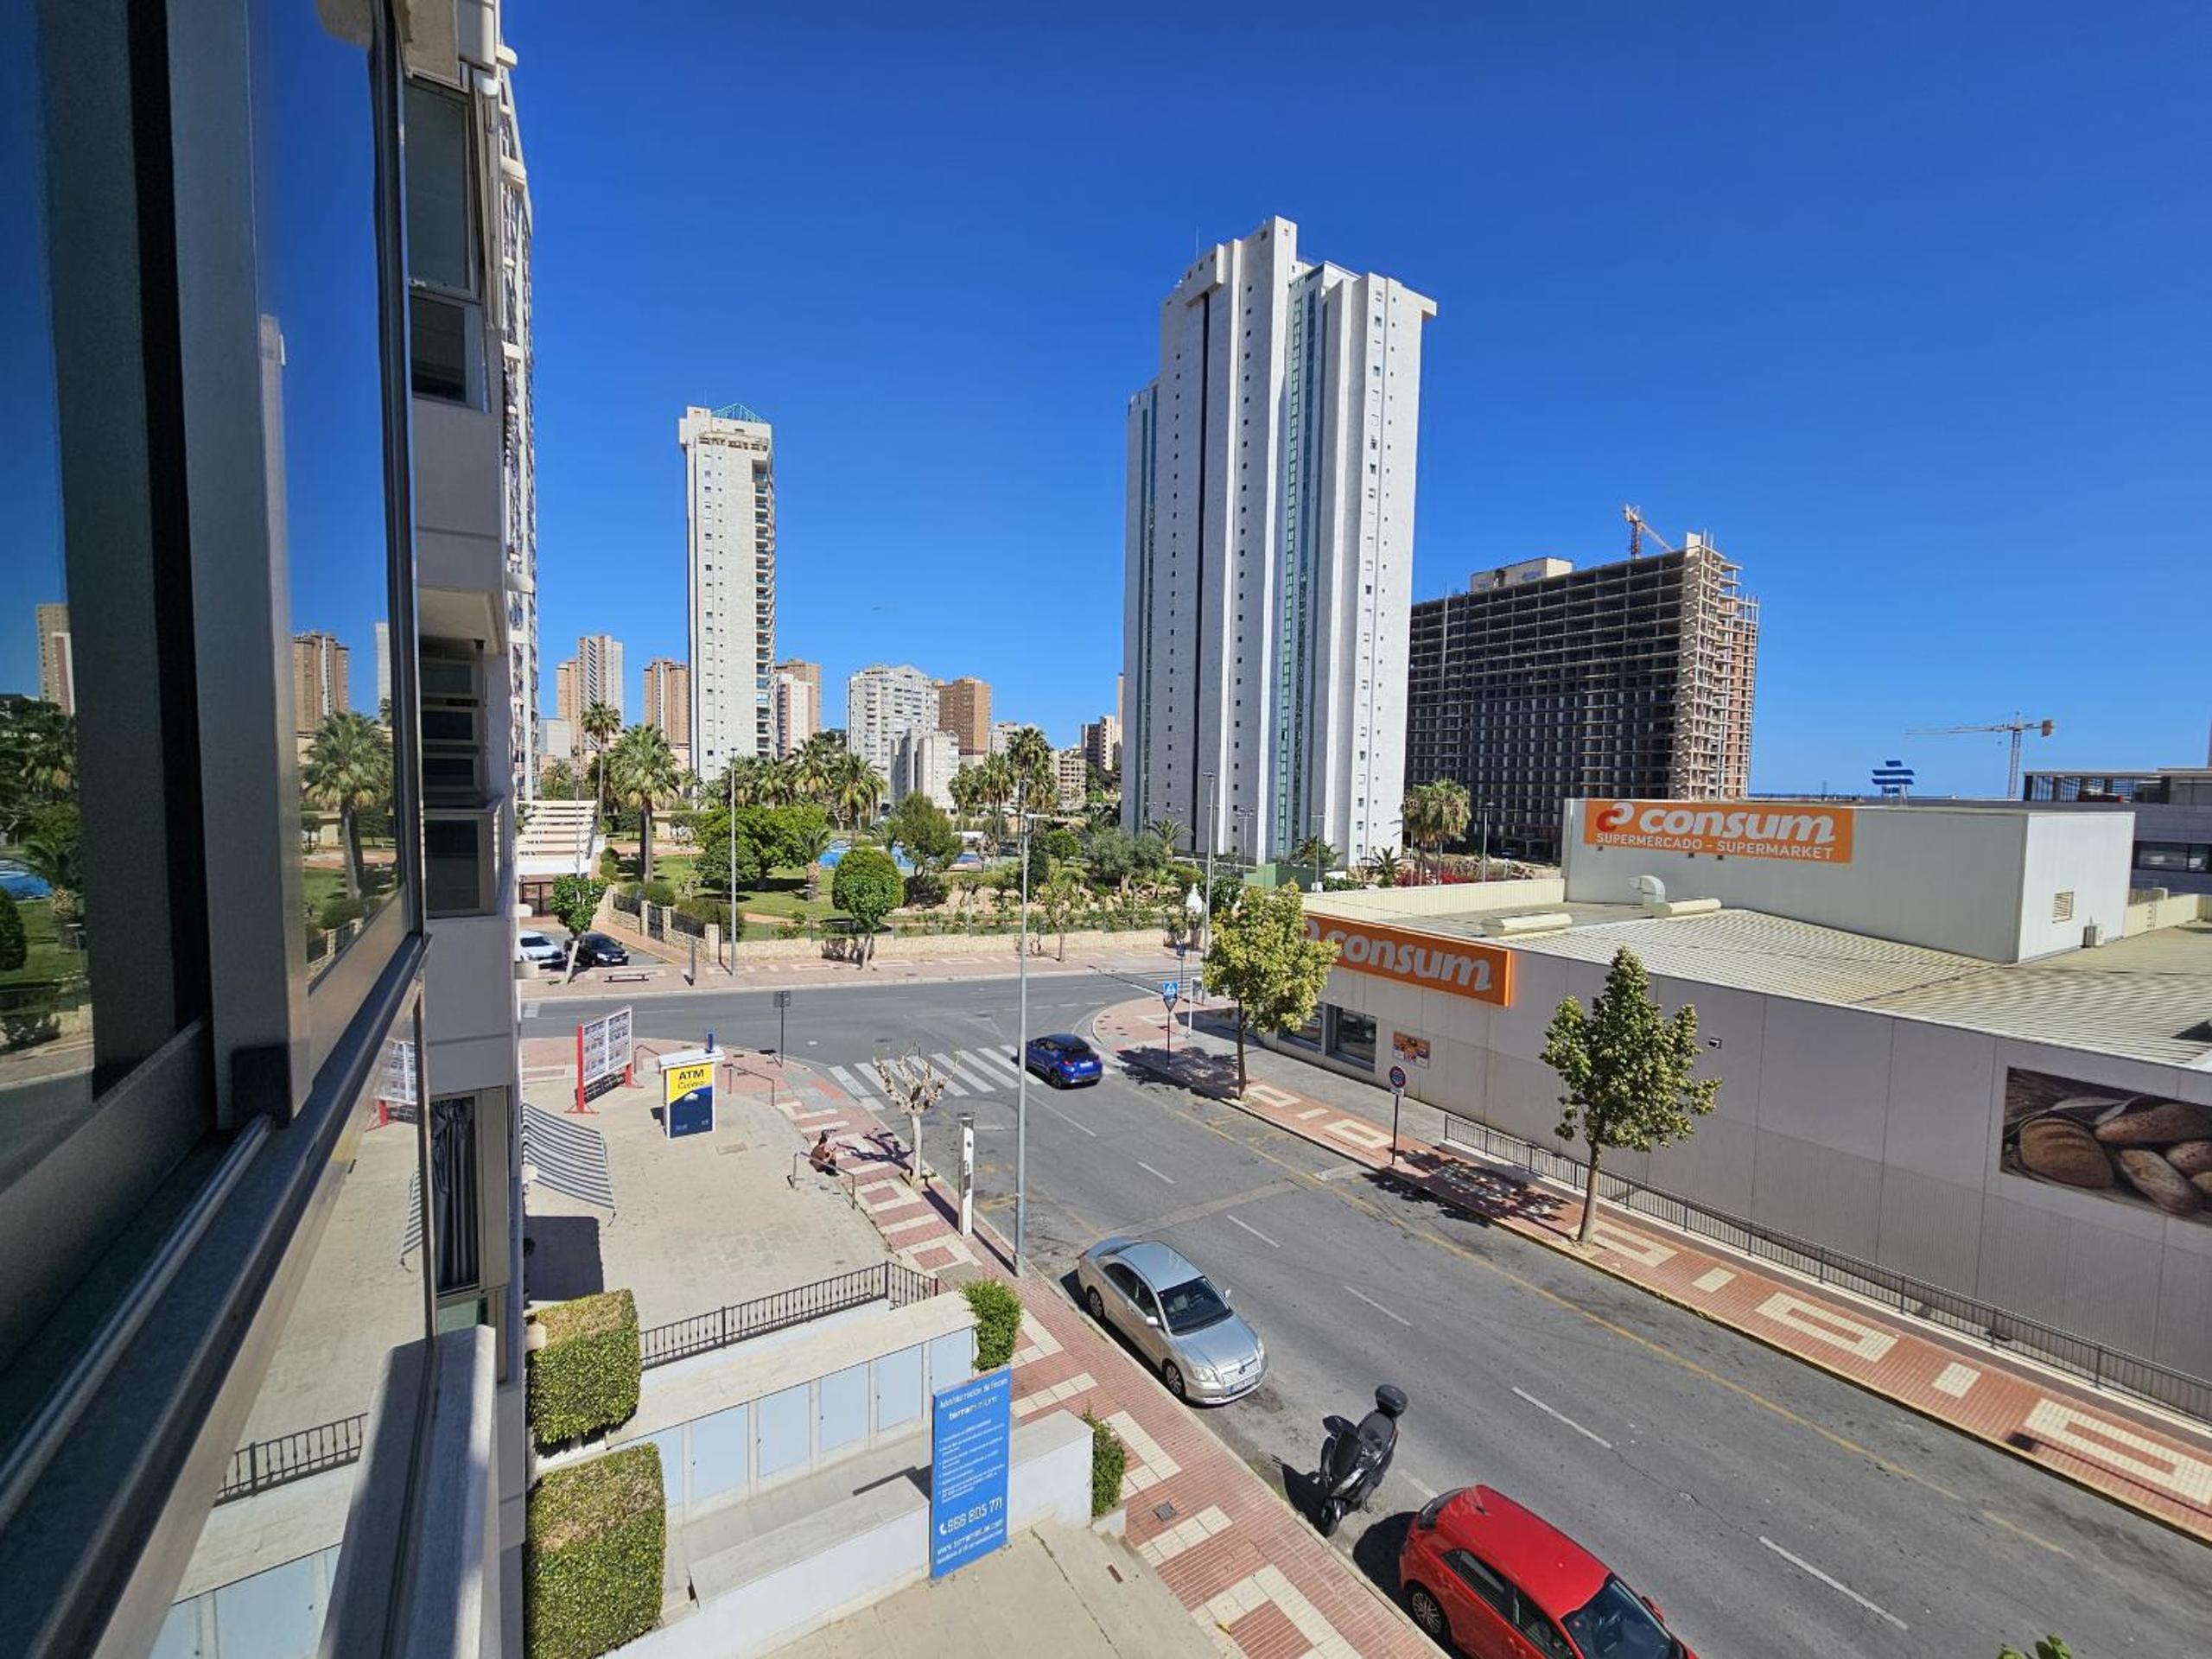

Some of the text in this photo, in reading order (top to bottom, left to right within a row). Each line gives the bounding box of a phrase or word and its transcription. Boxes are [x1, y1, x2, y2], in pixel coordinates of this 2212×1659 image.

[1638, 807, 1836, 844] consum
[1596, 832, 1703, 851] SUPERMERCADO
[1717, 841, 1835, 861] SUPERMARKET
[679, 1068, 704, 1081] ATM
